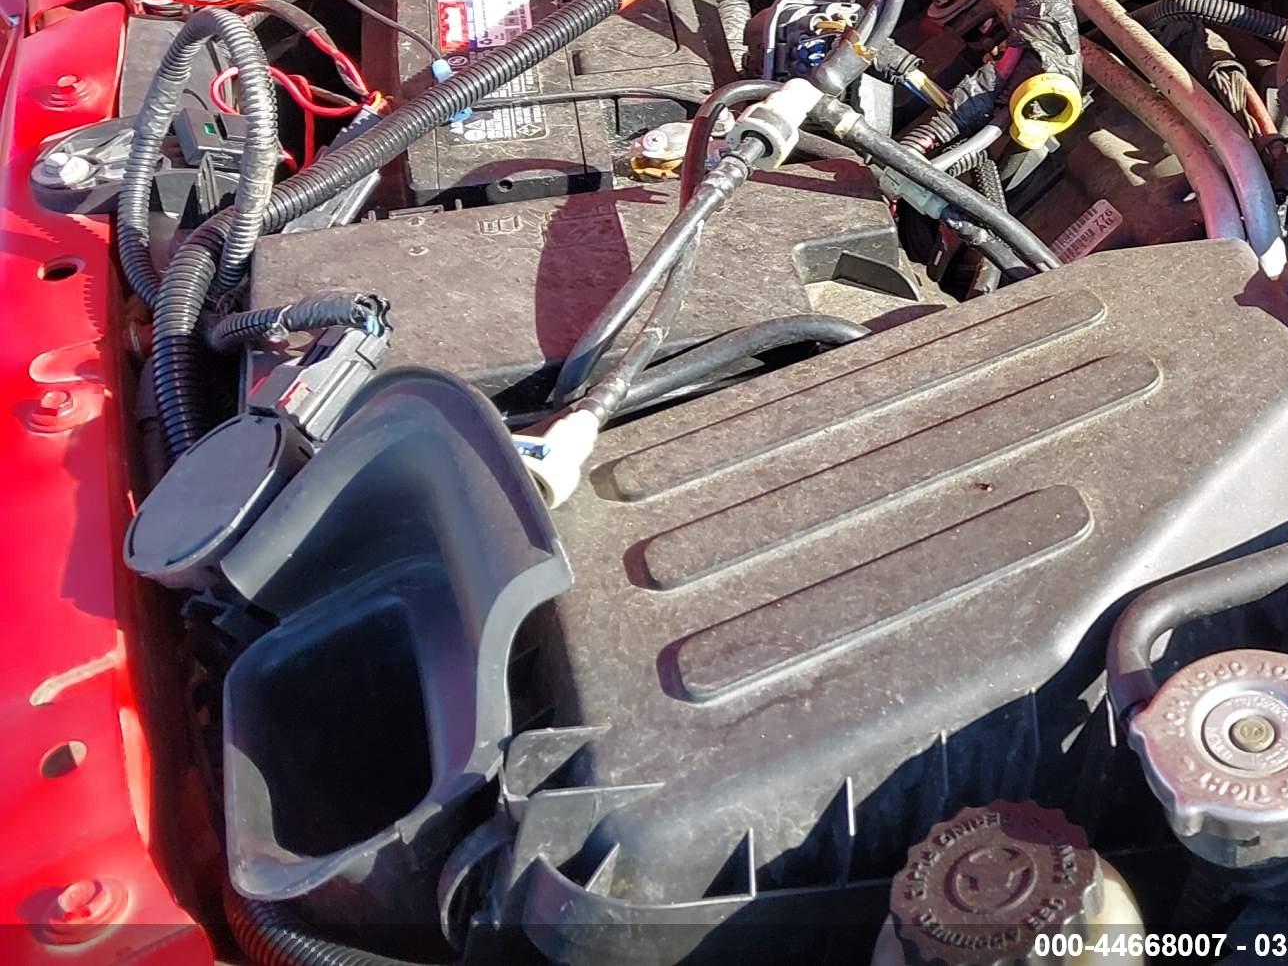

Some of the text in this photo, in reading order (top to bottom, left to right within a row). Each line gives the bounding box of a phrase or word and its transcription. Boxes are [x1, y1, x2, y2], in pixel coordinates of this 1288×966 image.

[1093, 208, 1113, 226] 776
[1181, 661, 1247, 698] OPEN
[1162, 697, 1192, 739] HOT
[1199, 771, 1273, 804] TIGHT
